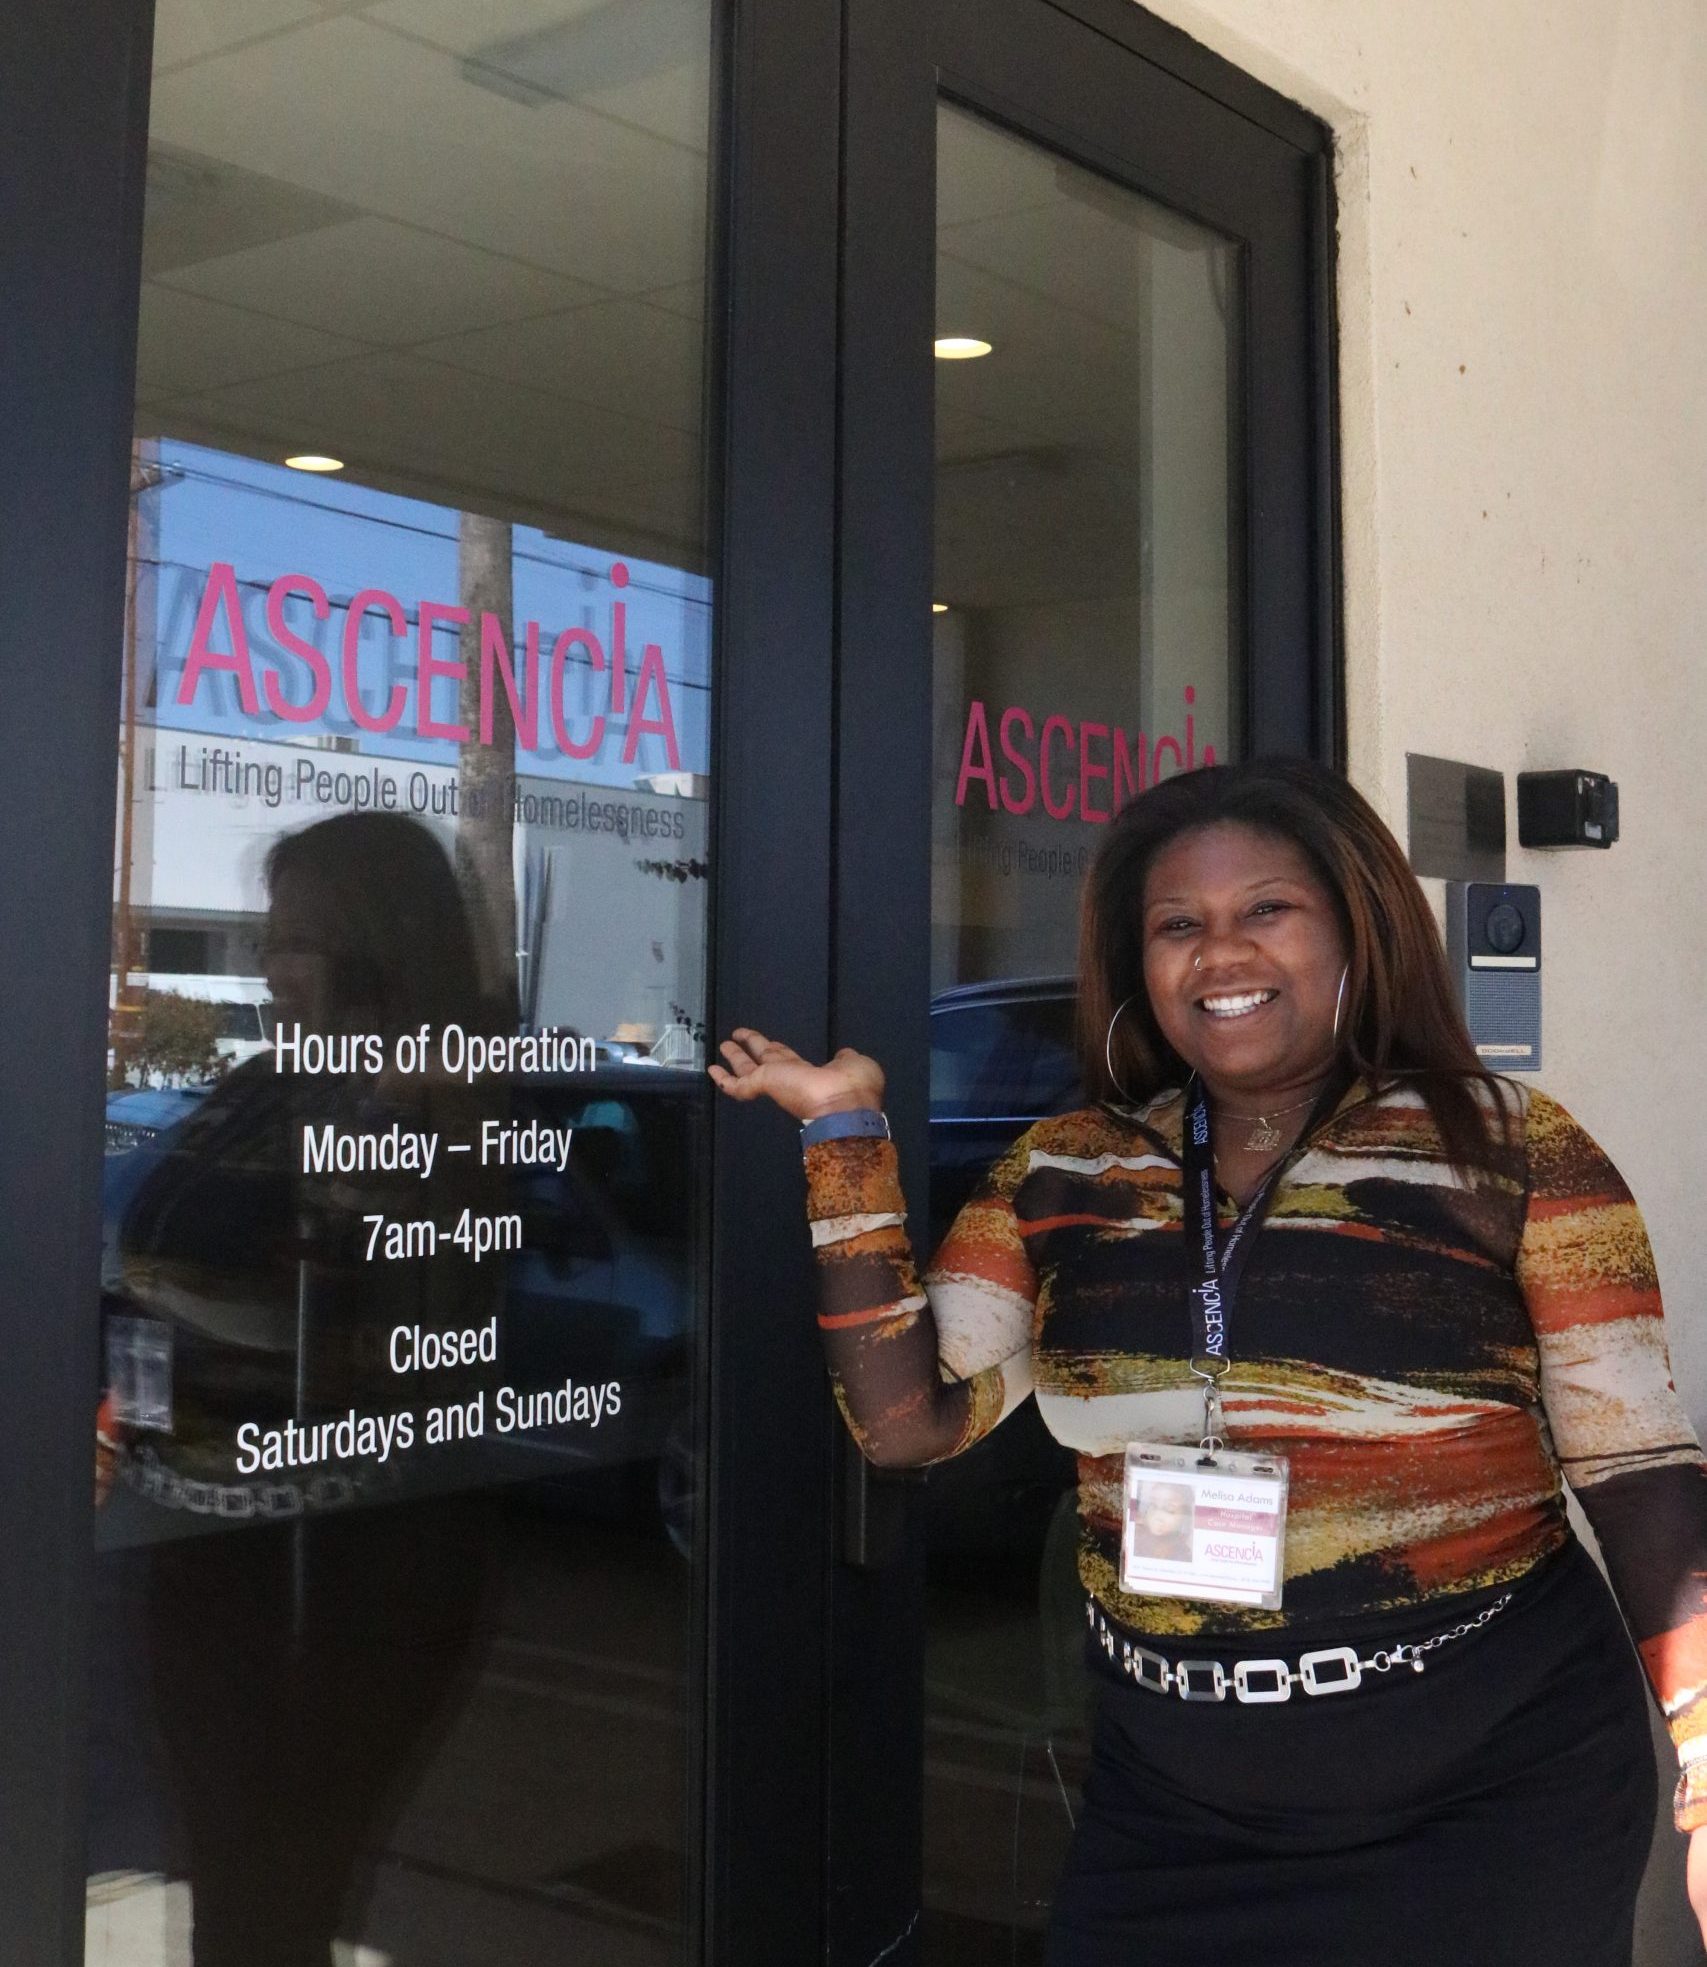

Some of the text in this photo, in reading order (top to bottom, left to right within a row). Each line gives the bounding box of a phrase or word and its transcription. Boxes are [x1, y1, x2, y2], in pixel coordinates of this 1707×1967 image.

[179, 745, 283, 808] Lifting
[296, 759, 397, 813] People
[409, 771, 458, 816] Out
[275, 1022, 596, 1083] Hours of Operation
[303, 1123, 438, 1178] Monday
[481, 1119, 573, 1171] Friday
[363, 1208, 522, 1262] 7am-4pm
[390, 1317, 496, 1373] Closed
[236, 1378, 621, 1474] Saturdays and Sundays
[1236, 1493, 1273, 1506] Adams
